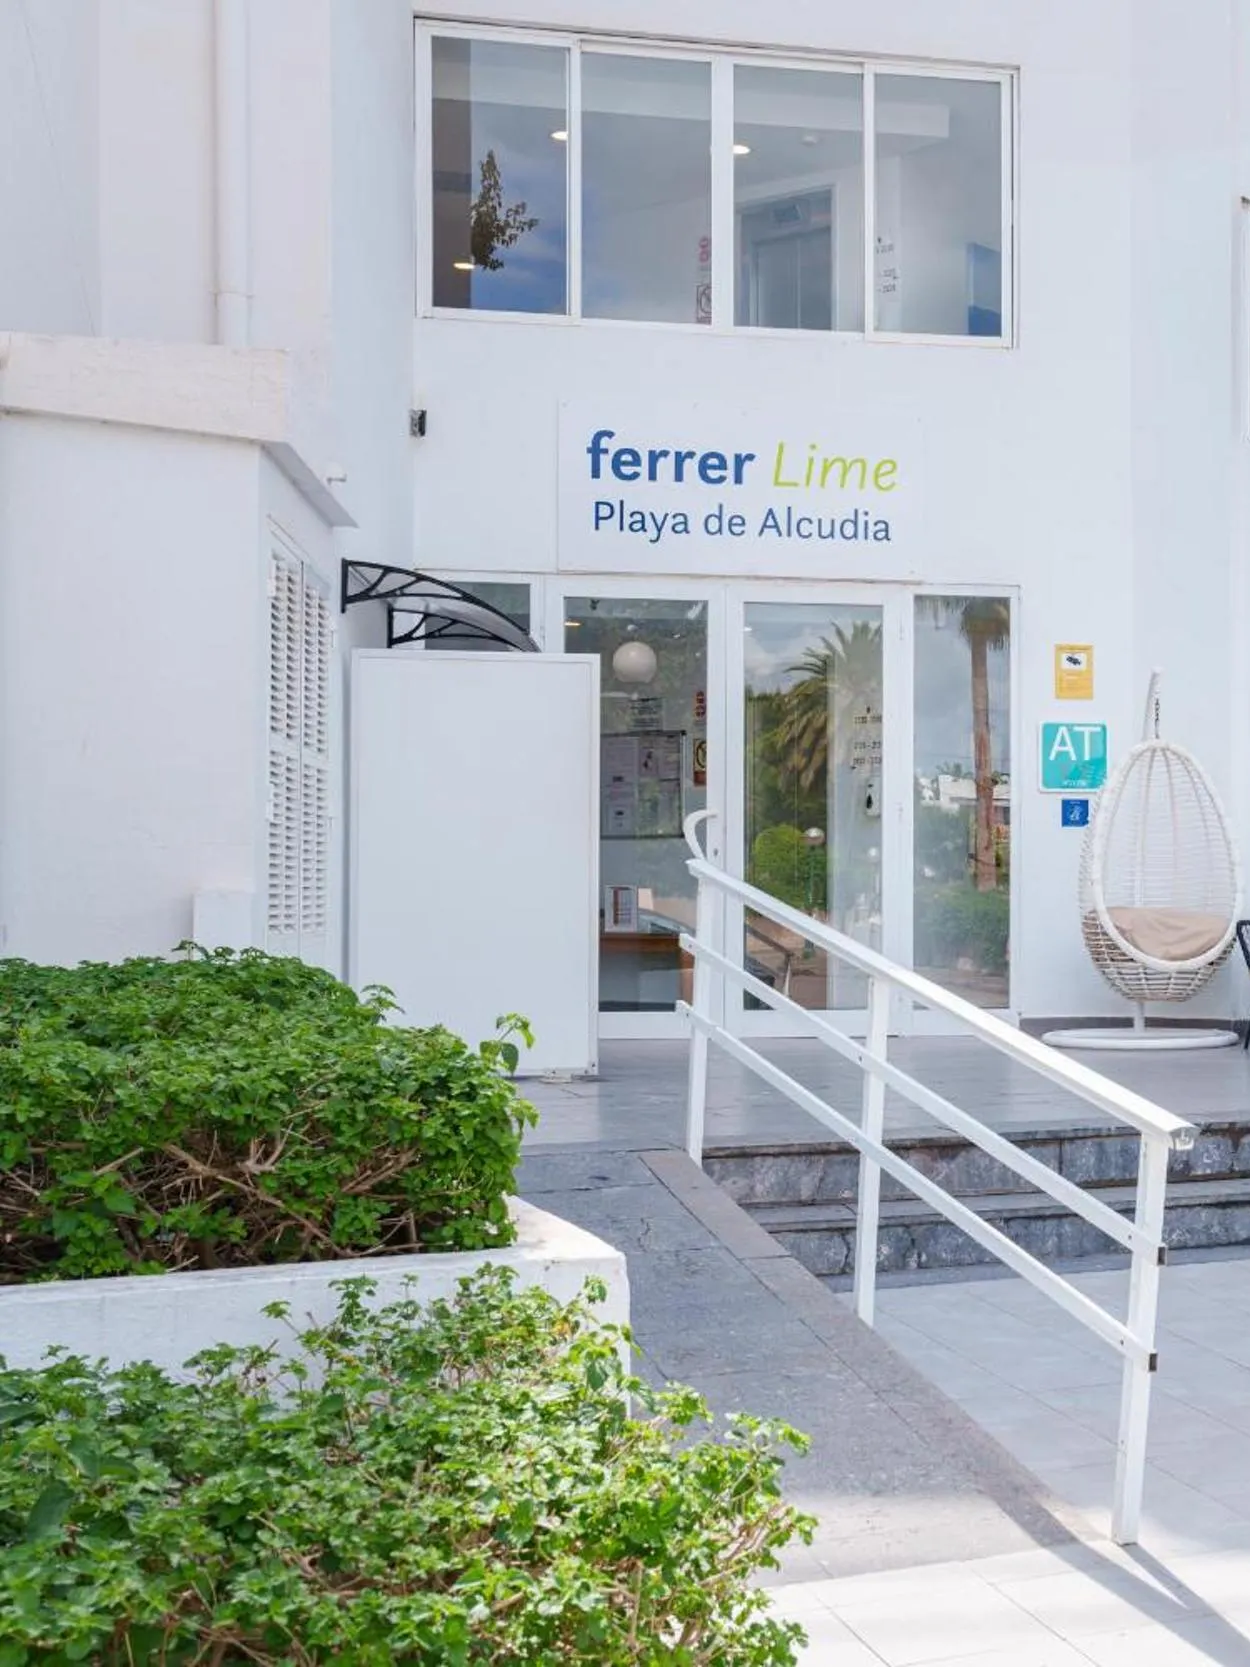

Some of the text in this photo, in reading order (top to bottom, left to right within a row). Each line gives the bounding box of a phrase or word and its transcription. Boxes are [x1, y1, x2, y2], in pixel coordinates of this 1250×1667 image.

[586, 430, 899, 493] ferrer Lime
[595, 500, 892, 545] Playa de Alcudia
[1049, 726, 1101, 762] AT
